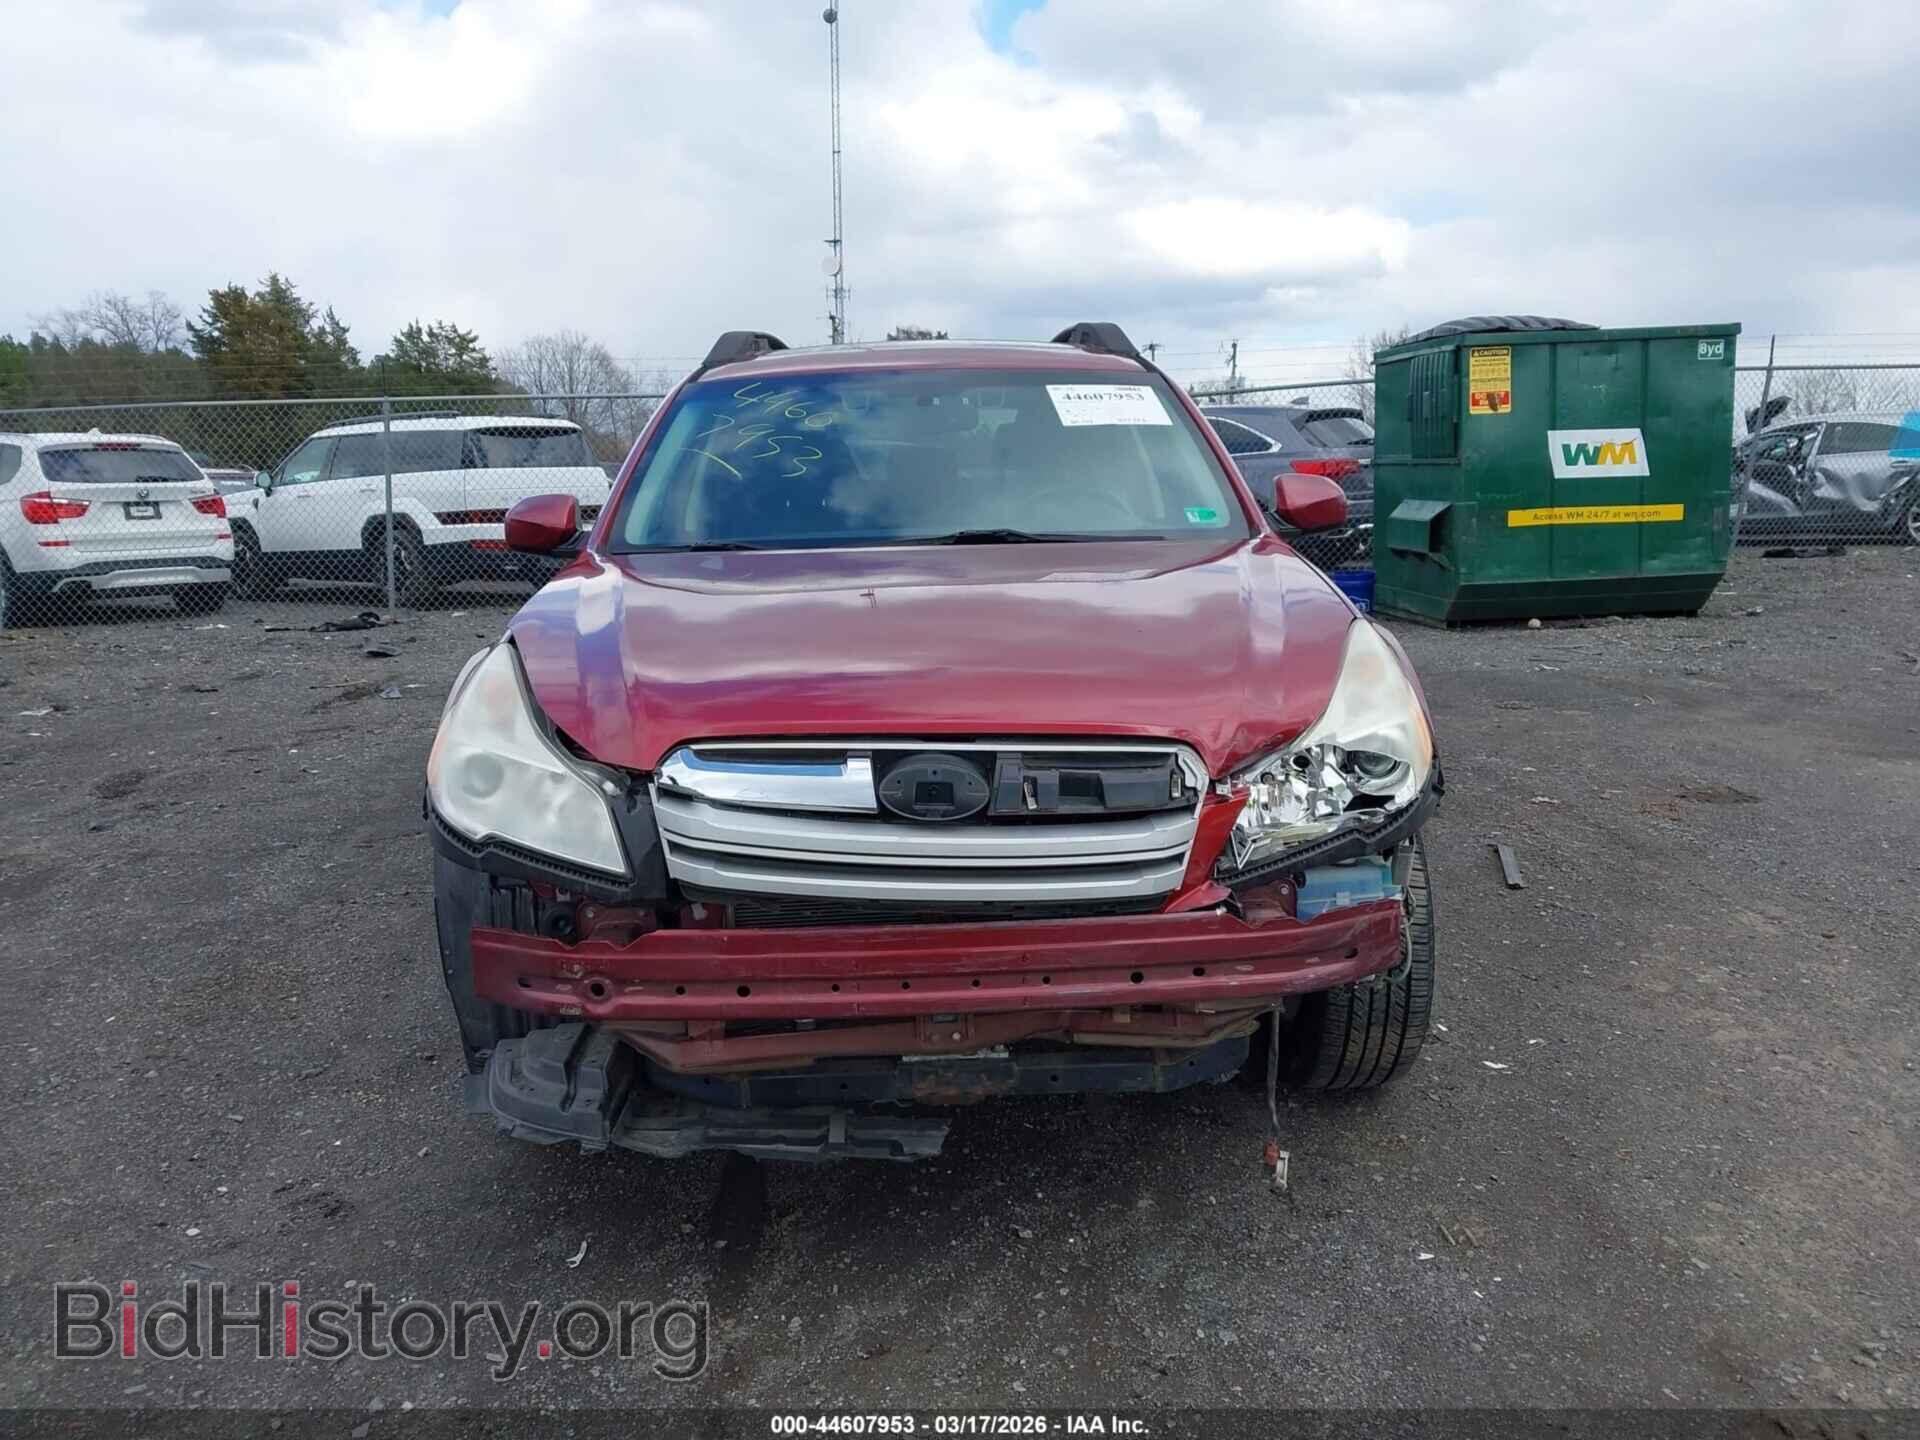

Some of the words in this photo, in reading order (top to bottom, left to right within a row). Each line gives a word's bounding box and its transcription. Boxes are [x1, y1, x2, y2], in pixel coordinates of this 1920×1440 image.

[1561, 442, 1636, 466] WM
[1567, 512, 1584, 520] WM
[1587, 511, 1609, 519] 24/7
